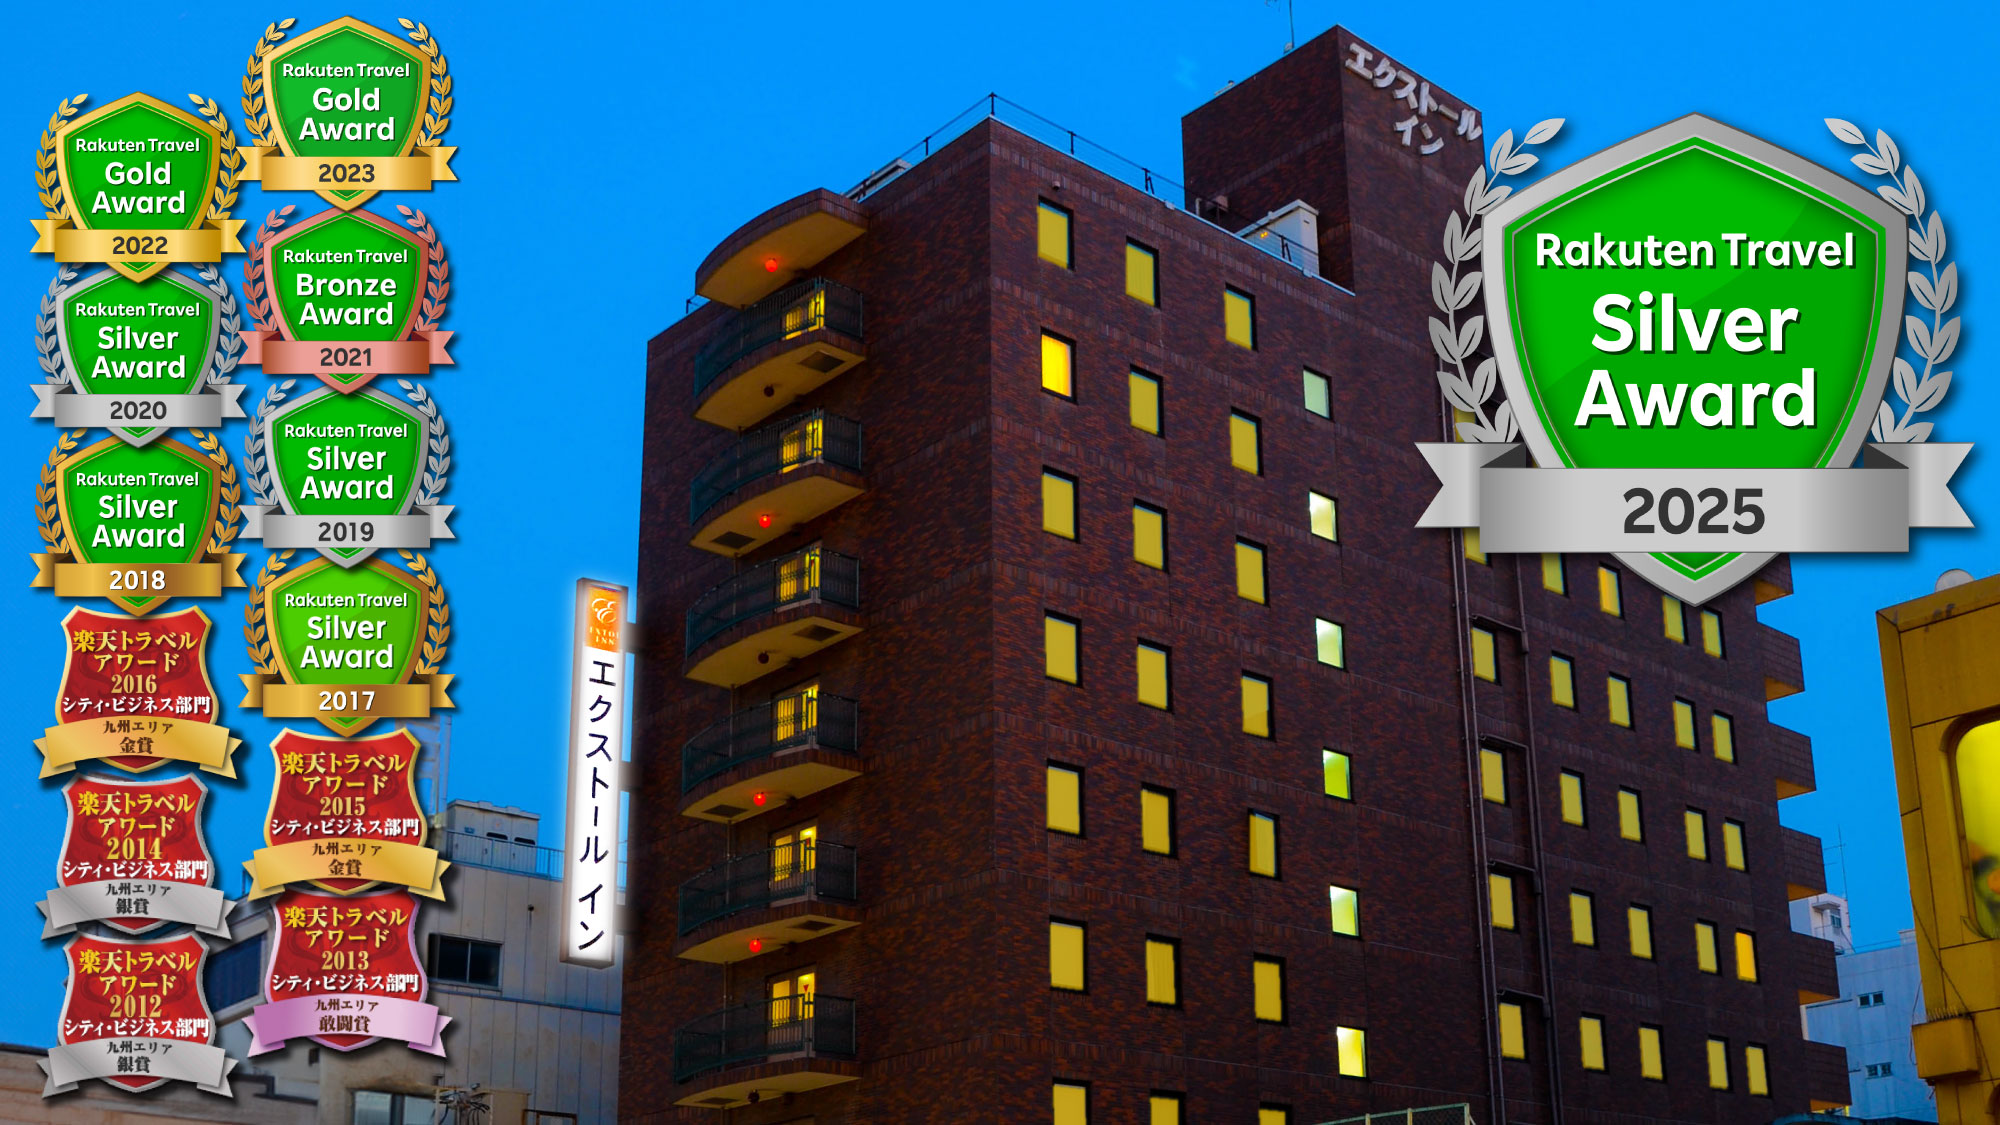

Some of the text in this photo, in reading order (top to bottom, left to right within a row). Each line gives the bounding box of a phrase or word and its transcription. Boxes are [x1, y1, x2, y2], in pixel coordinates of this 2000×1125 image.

[1345, 42, 1483, 141] エクストール
[1394, 115, 1444, 155] イン
[578, 660, 616, 951] エクストール イン
